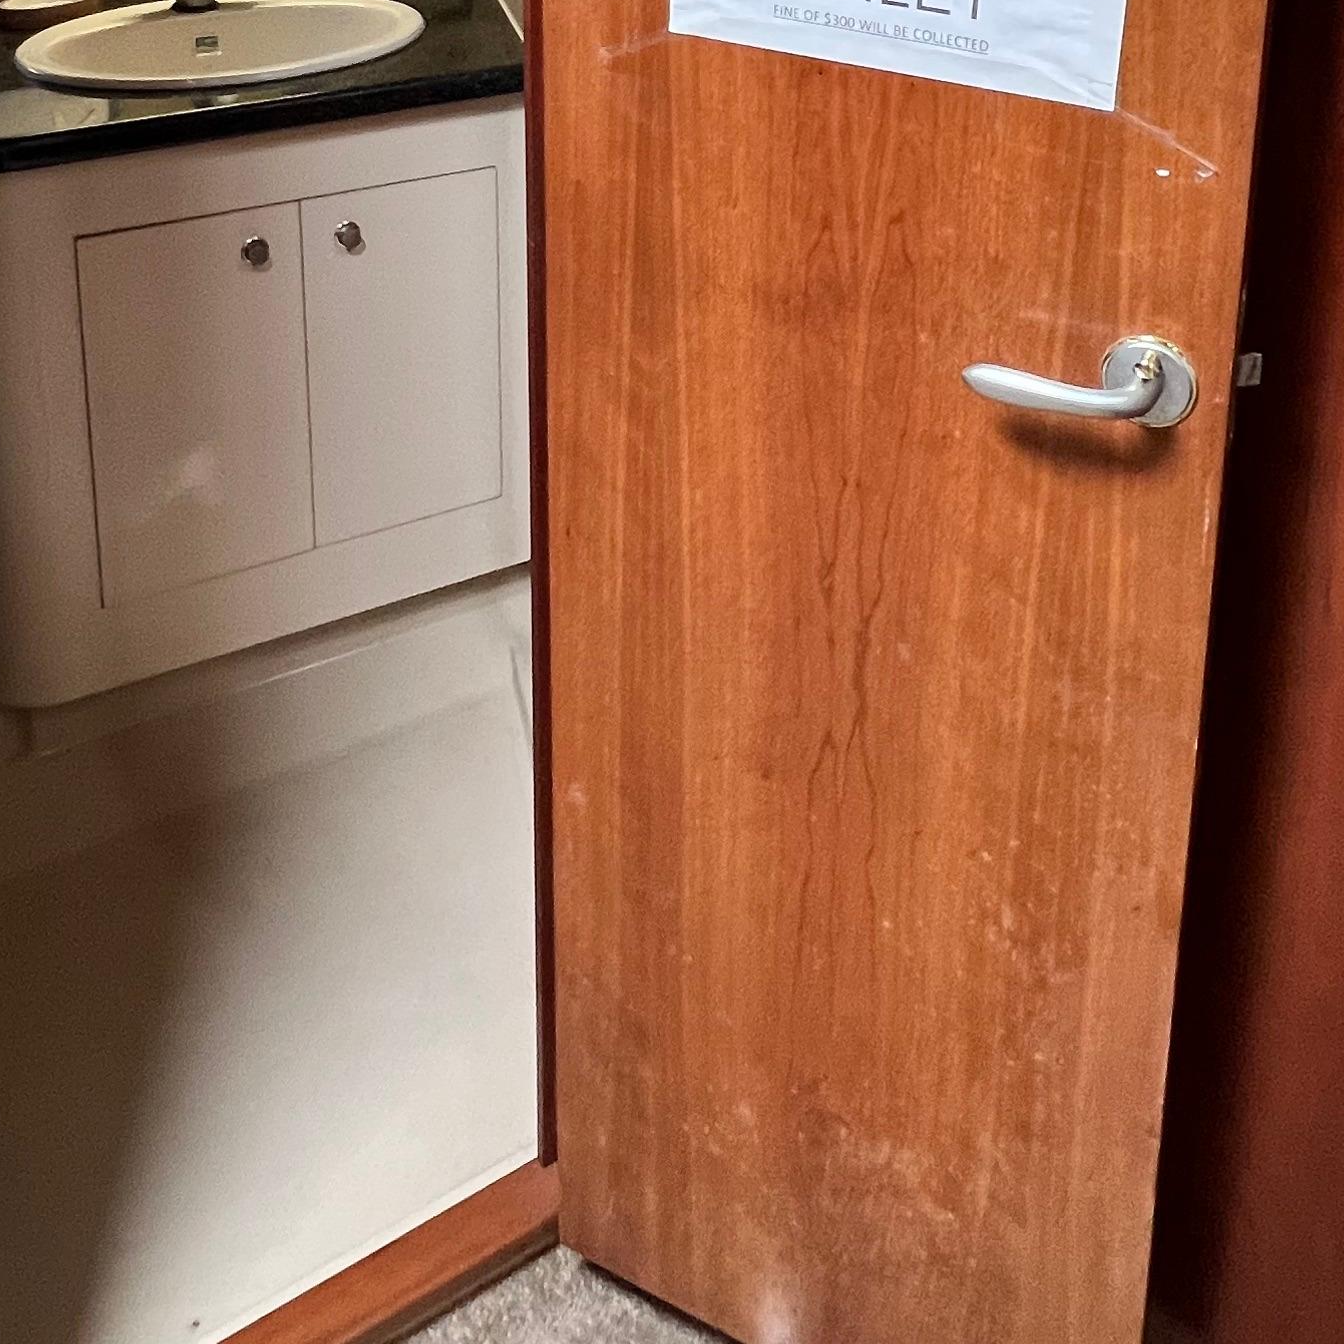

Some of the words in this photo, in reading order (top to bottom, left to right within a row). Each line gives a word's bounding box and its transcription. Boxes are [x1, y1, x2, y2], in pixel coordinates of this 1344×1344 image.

[773, 3, 800, 20] FINE
[803, 9, 821, 23] OF
[824, 12, 856, 29] $300
[858, 19, 890, 36] WILL
[893, 24, 909, 38] BE
[912, 28, 990, 54] COLLECTED
